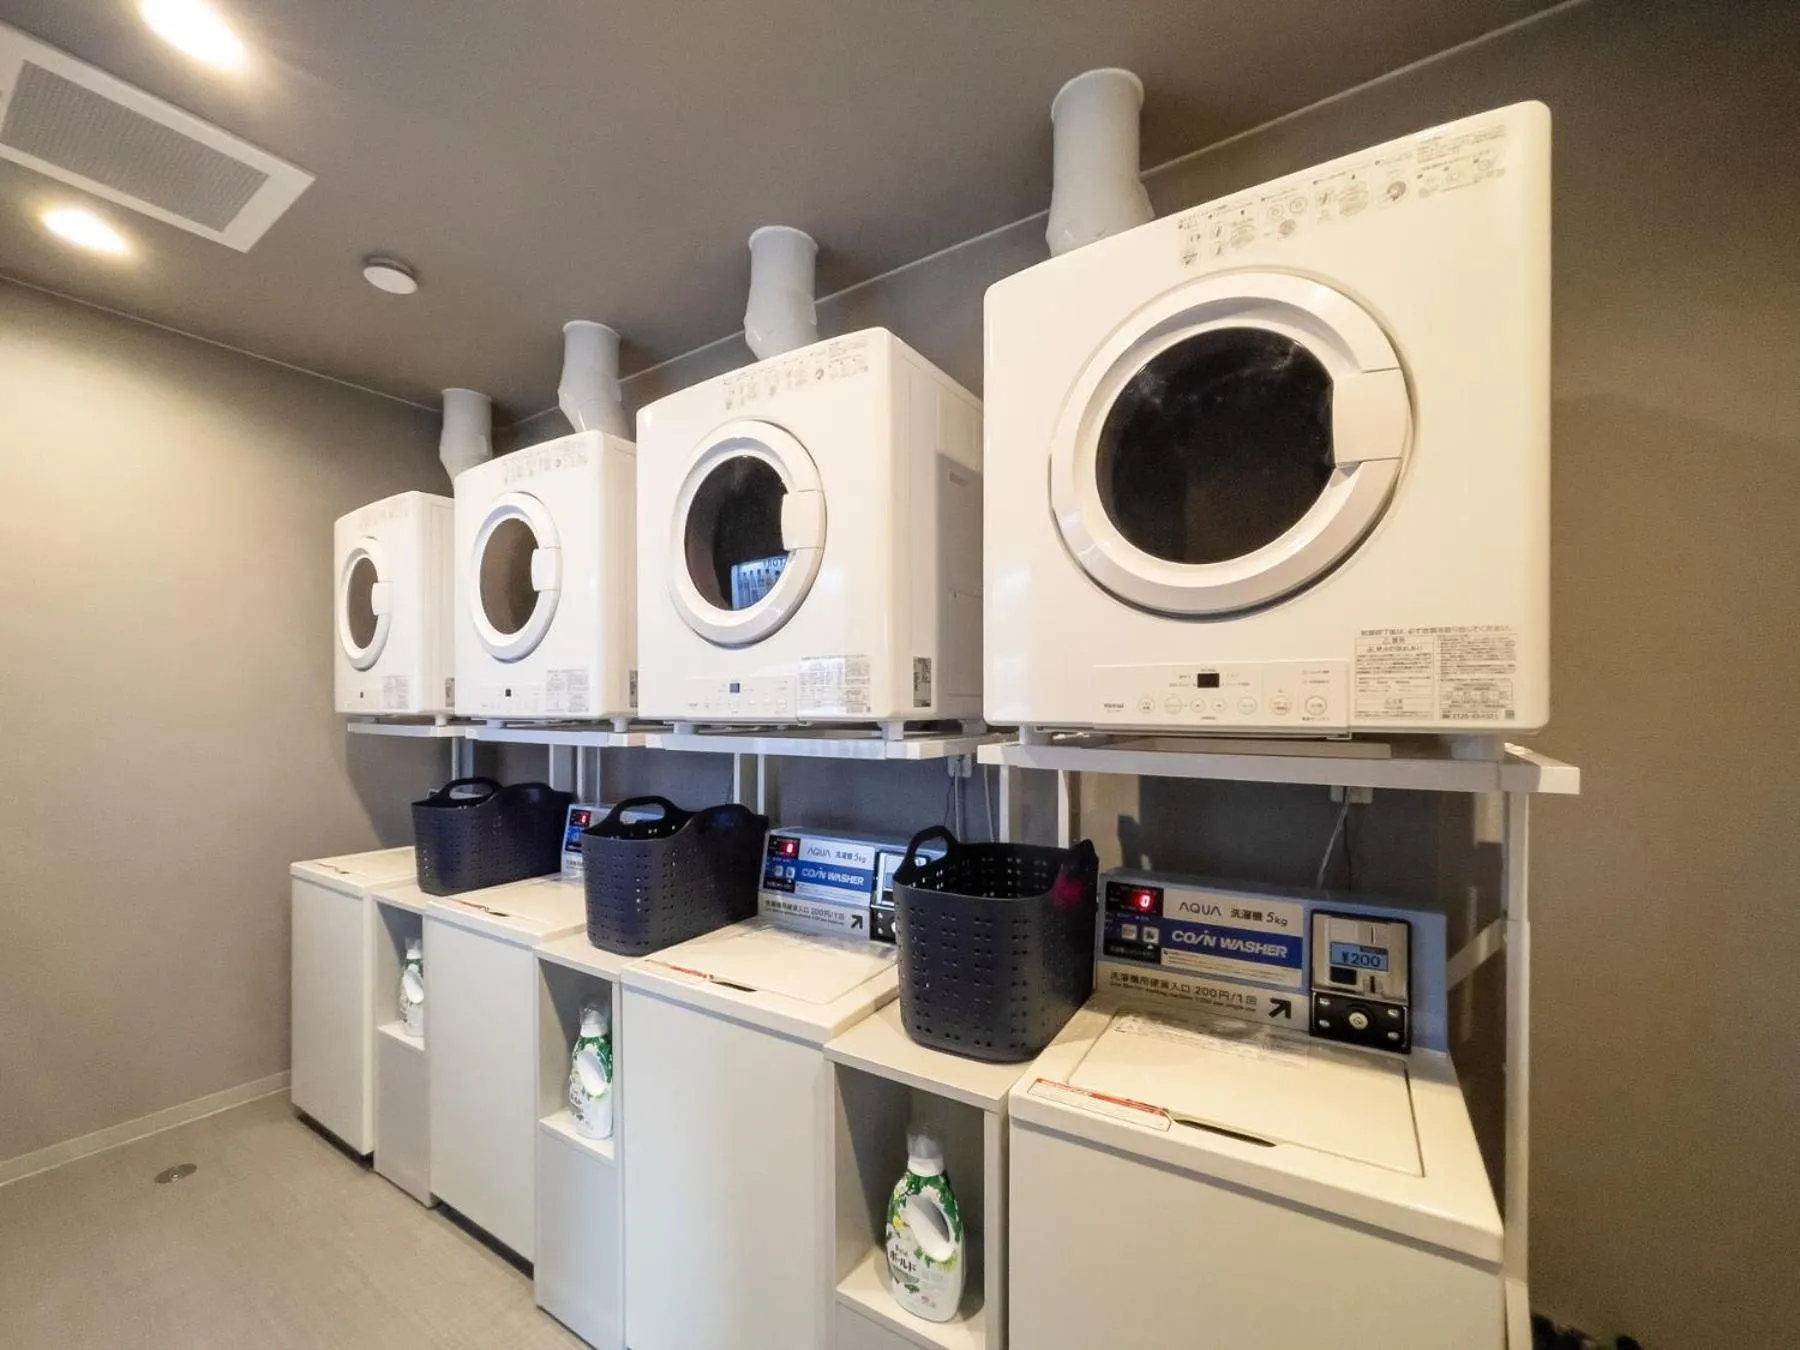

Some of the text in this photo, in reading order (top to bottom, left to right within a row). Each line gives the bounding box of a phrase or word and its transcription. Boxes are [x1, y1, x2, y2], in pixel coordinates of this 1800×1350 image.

[828, 871, 865, 886] WASHER
[1178, 901, 1222, 917] AQUA
[1265, 911, 1288, 927] 5kg
[1171, 929, 1288, 958] COIN WASHER
[1342, 951, 1381, 968] ¥200
